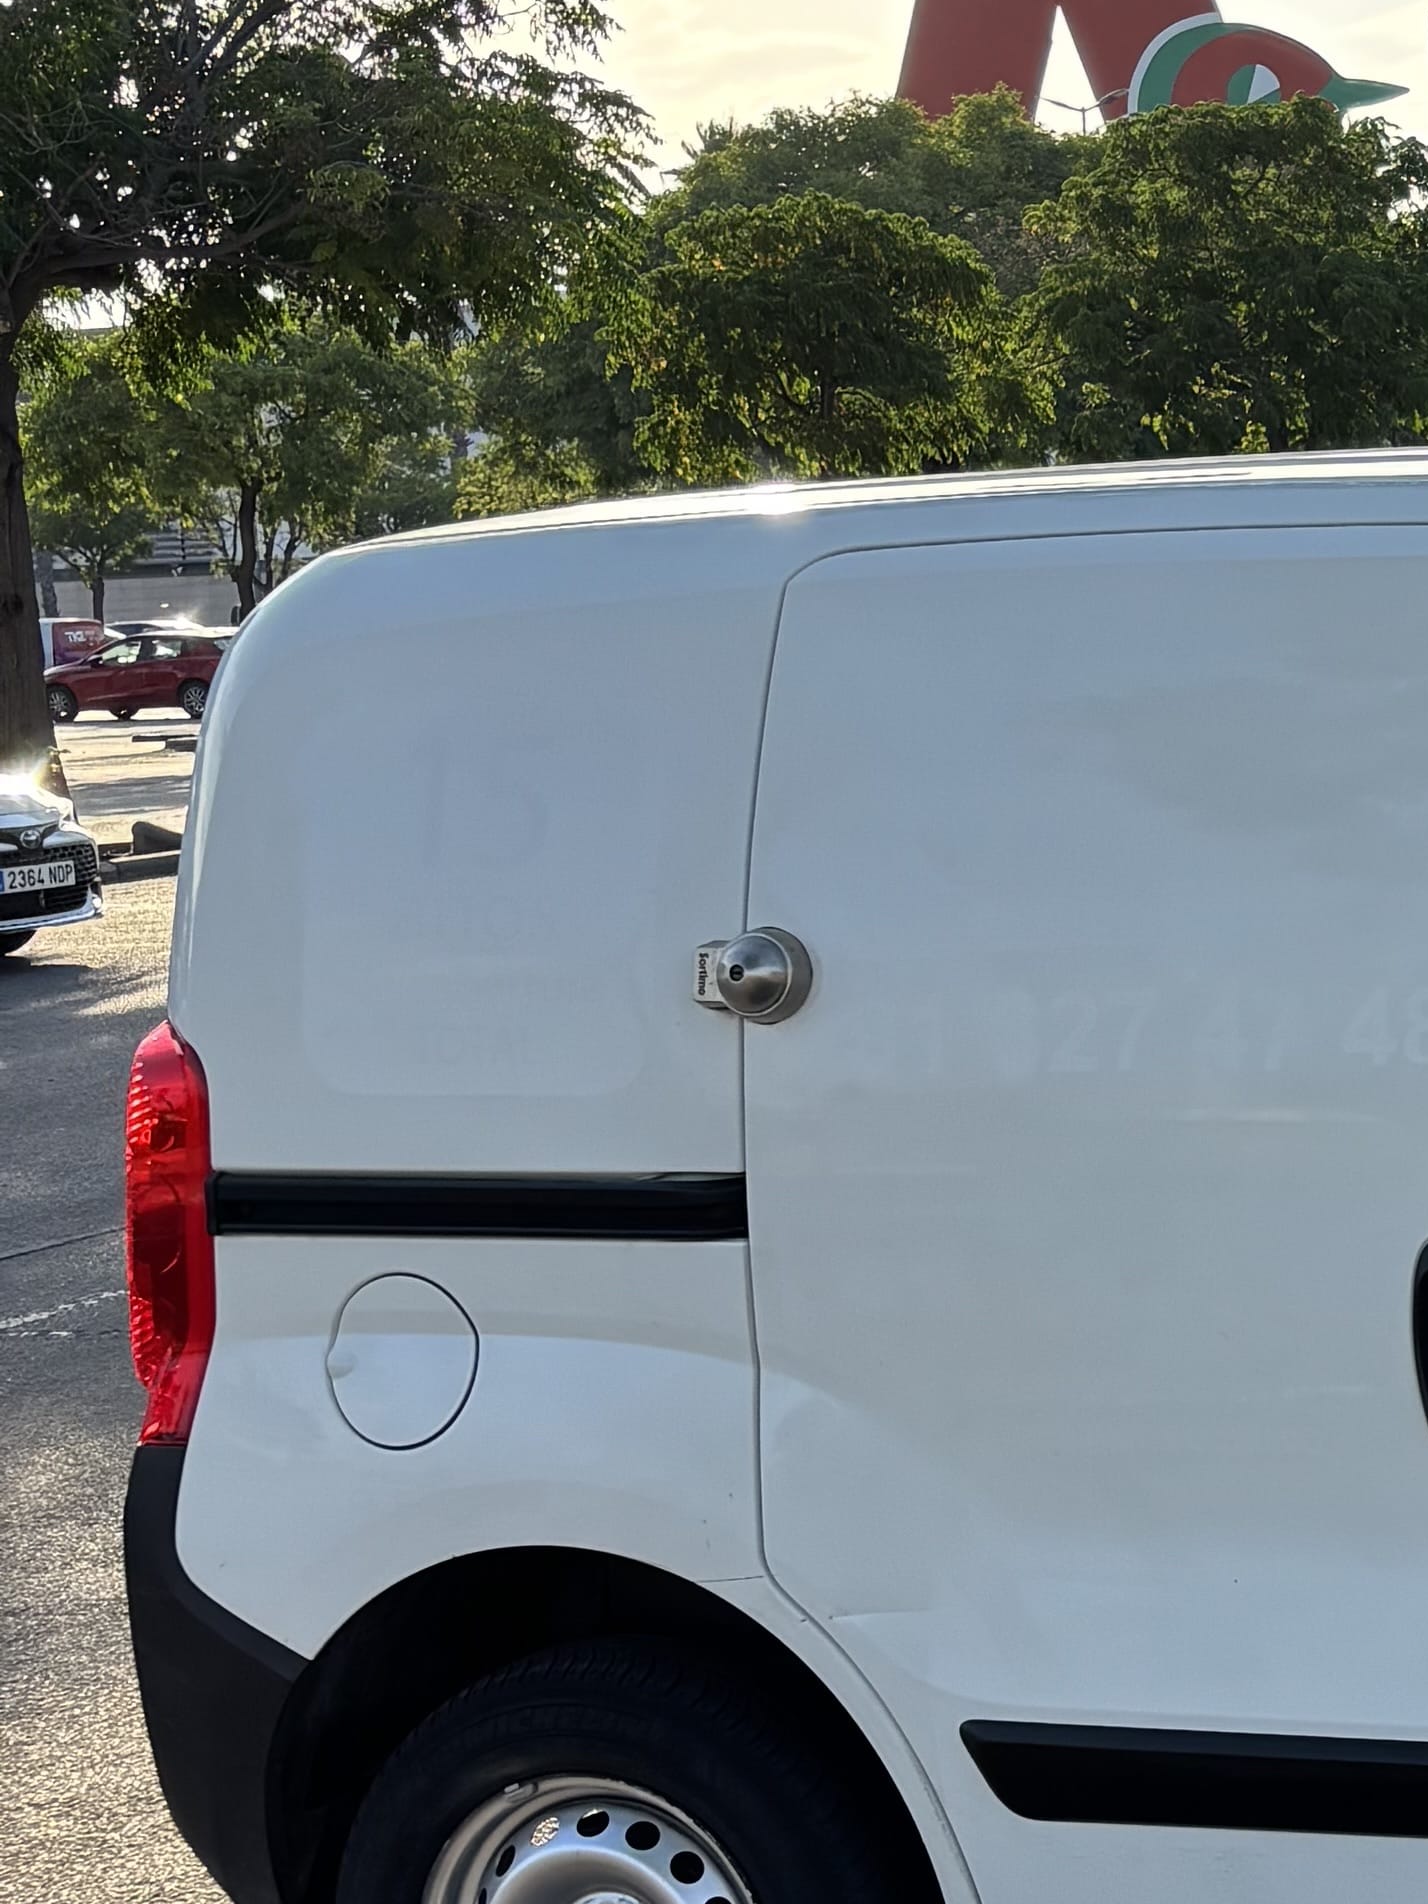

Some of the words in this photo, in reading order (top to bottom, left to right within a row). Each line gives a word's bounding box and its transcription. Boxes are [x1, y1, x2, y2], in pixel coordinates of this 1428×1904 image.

[7, 867, 45, 890] 2364
[48, 863, 73, 885] NDP
[698, 953, 709, 996] Sortimo
